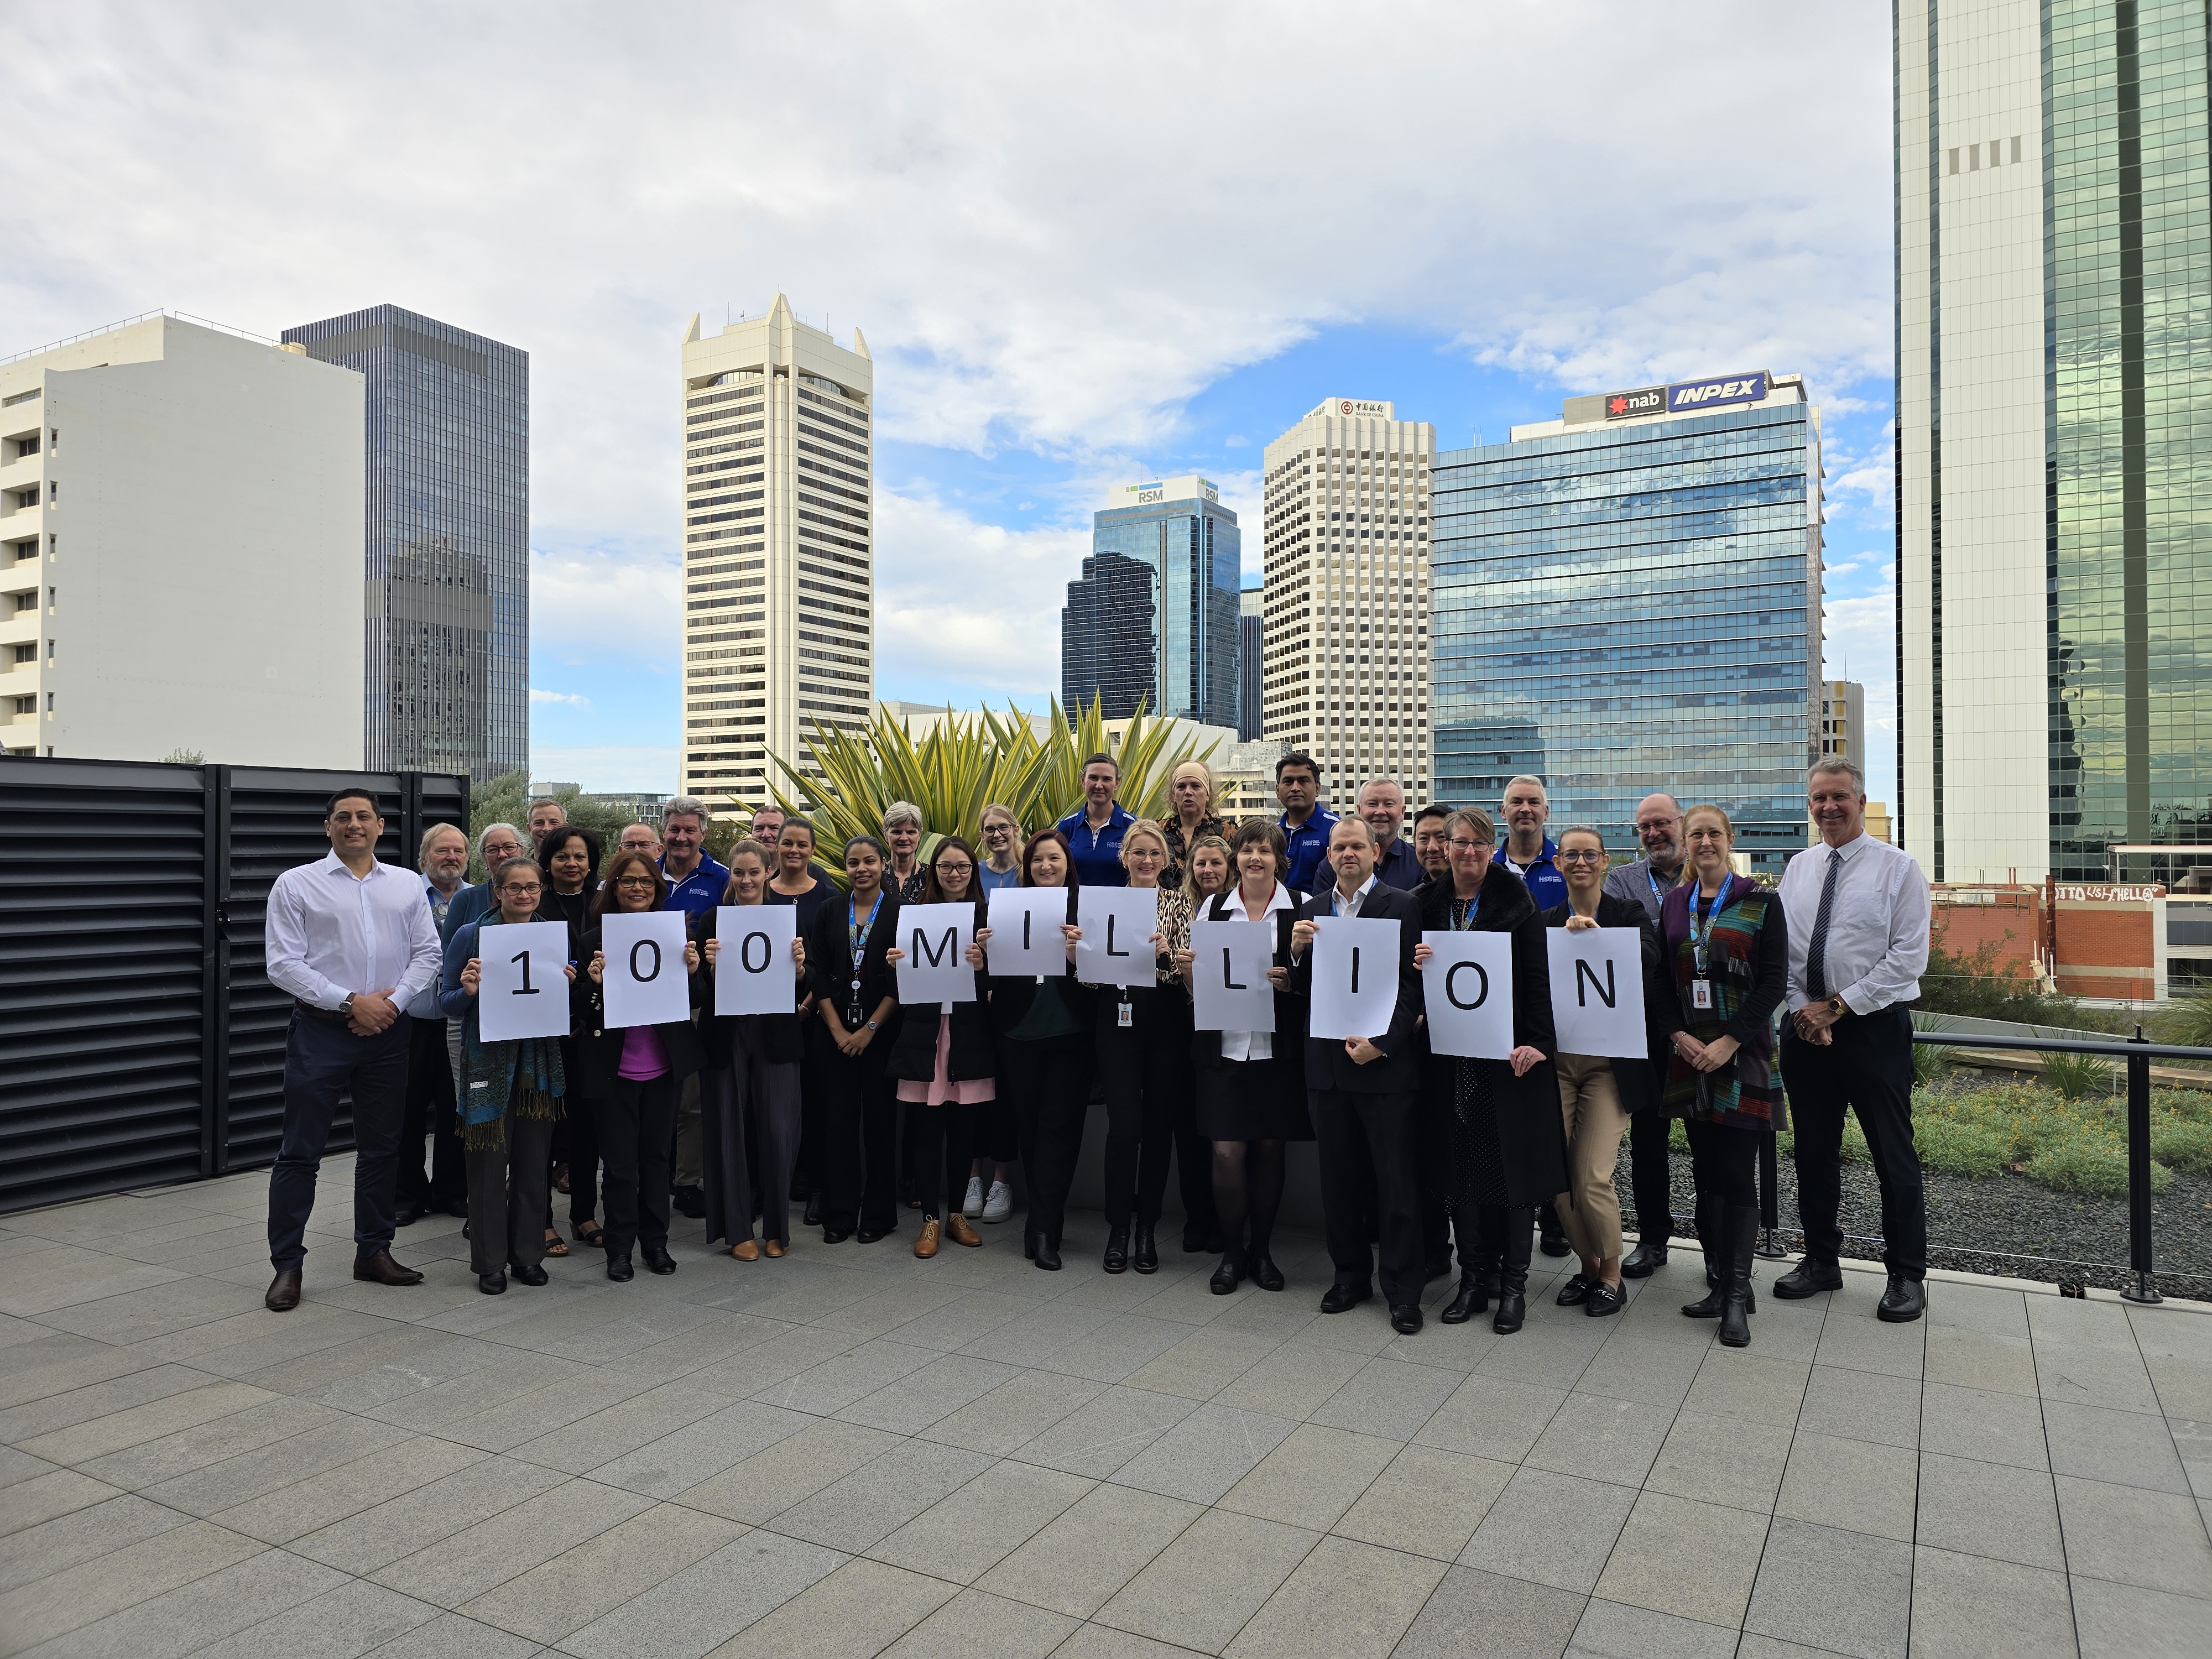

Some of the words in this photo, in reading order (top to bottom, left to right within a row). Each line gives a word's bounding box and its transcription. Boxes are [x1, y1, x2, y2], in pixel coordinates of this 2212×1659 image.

[1629, 392, 1659, 409] nab
[1674, 379, 1758, 405] INPEX
[1139, 490, 1163, 503] RSM
[1206, 488, 1218, 504] RSM
[912, 927, 958, 968] M
[1024, 910, 1031, 950] I
[1107, 914, 1130, 957] L
[511, 951, 540, 995] 1
[629, 939, 661, 982] 0
[742, 931, 771, 973] 0
[1223, 947, 1247, 990] L
[1351, 947, 1360, 994] I
[1446, 961, 1489, 1010] O
[1575, 959, 1616, 1008] N
